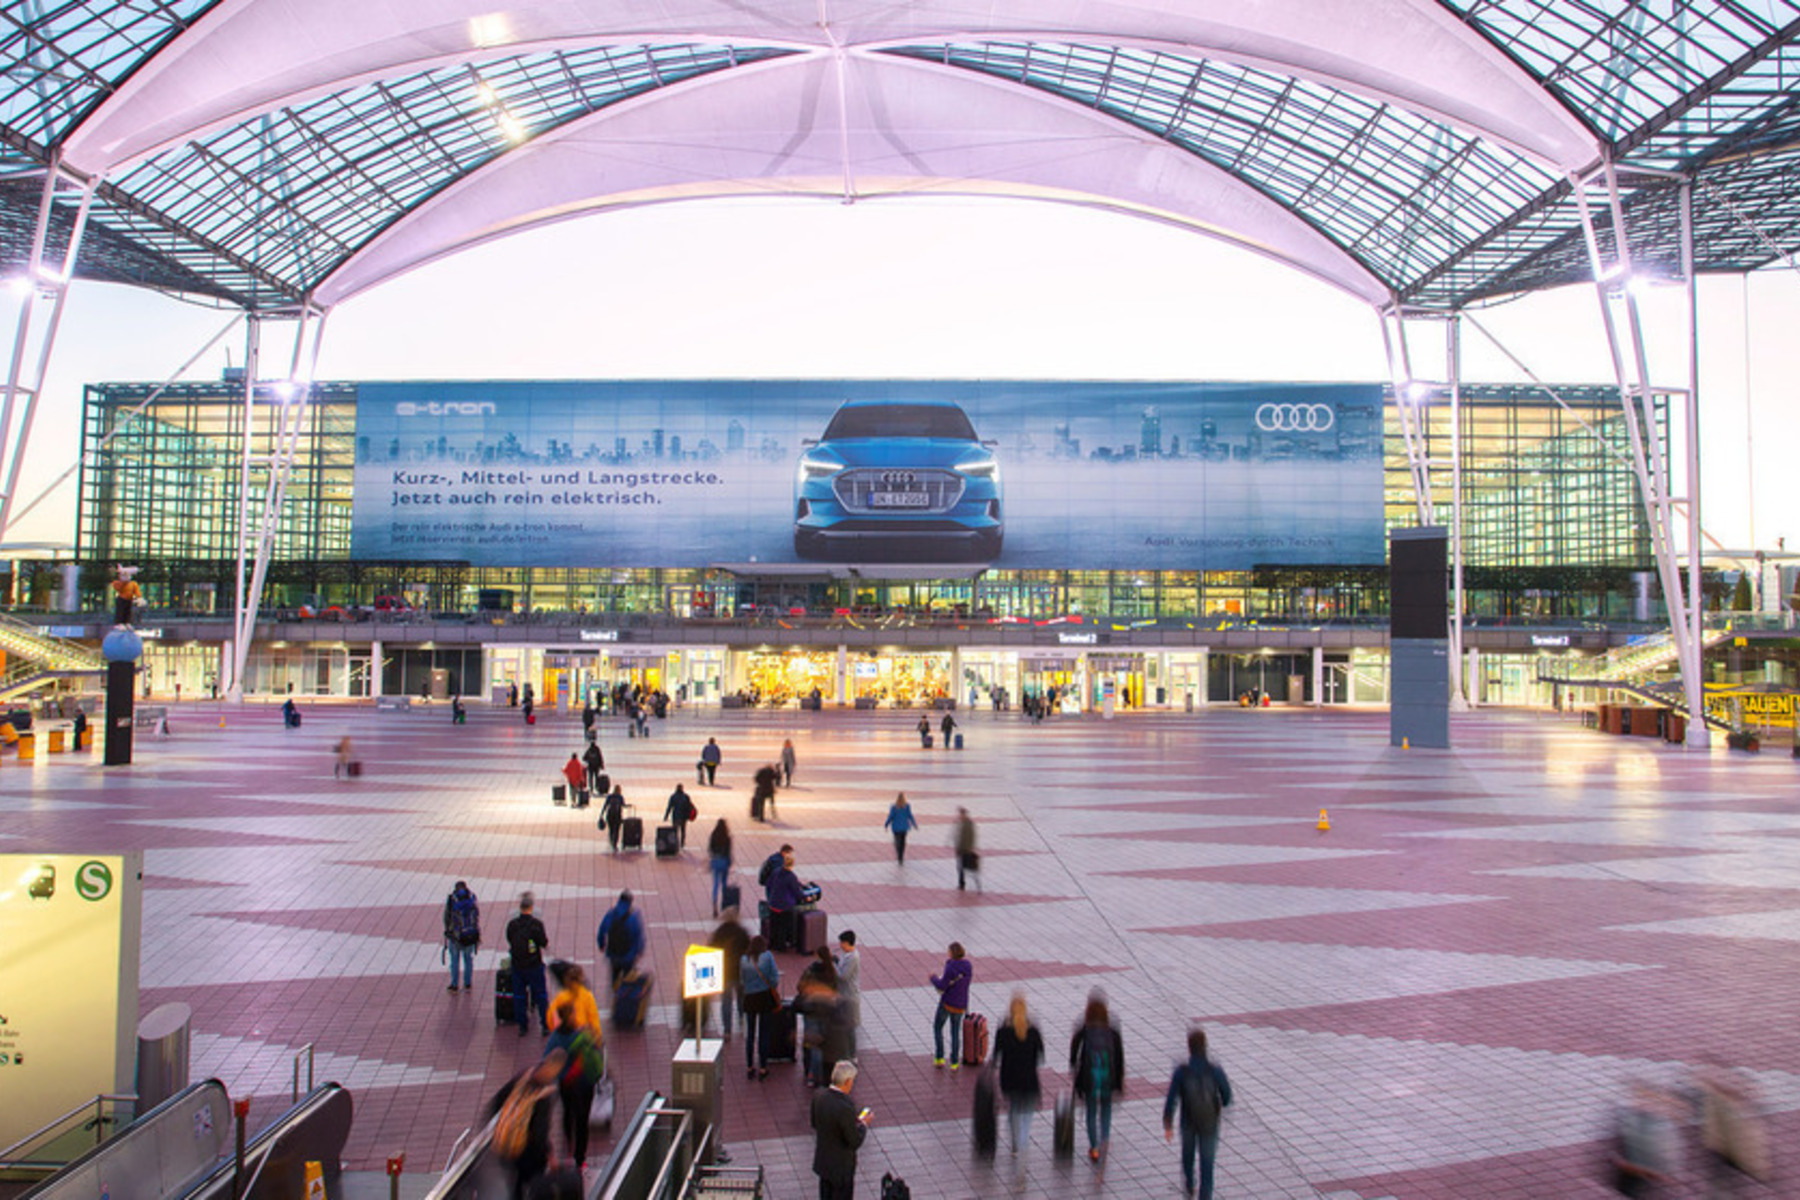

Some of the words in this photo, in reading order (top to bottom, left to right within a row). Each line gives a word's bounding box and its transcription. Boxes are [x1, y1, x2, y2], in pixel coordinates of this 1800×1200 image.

[396, 402, 496, 416] e-tron
[392, 471, 453, 486] Kurz-,
[461, 471, 533, 485] Mittel-
[540, 471, 580, 485] und
[588, 471, 724, 488] Langstrecke.
[391, 491, 443, 506] Jetzt
[448, 491, 497, 505] auch
[504, 491, 544, 505] rein
[551, 491, 662, 505] elektrisch.
[392, 523, 409, 532] Der
[411, 523, 431, 532] rein
[433, 523, 487, 532] elektrische
[489, 523, 512, 532] Audi
[1144, 537, 1175, 547] Audi
[1178, 537, 1243, 549] Vorsprung
[1246, 536, 1284, 547] durch
[1287, 537, 1335, 547] Technik
[81, 863, 108, 898] S
